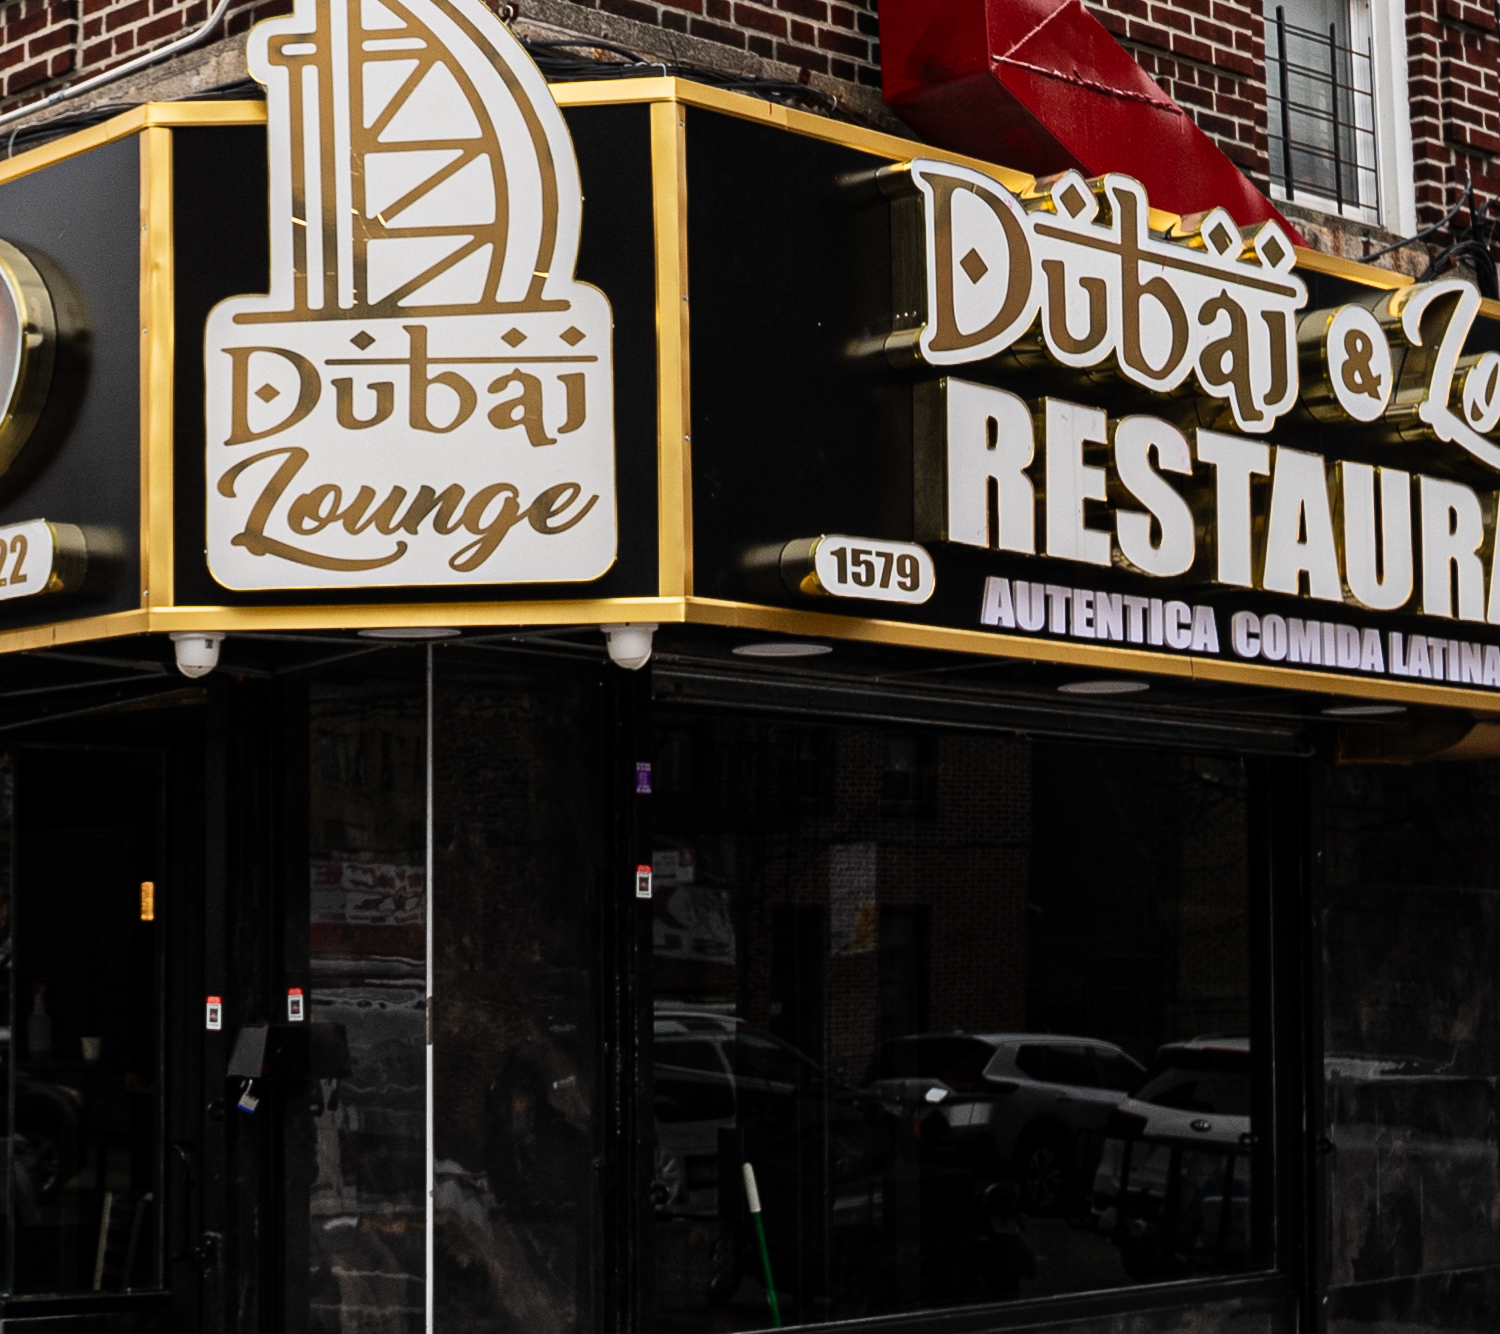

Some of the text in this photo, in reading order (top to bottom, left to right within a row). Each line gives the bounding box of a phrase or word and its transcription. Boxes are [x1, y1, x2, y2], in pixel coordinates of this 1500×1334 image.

[920, 162, 1305, 432] Dubai
[1340, 325, 1385, 402] &
[222, 323, 600, 450] Dubai
[217, 443, 600, 573] Lounge
[829, 544, 921, 595] 1579
[981, 575, 1219, 654] AUTENTICA
[1231, 610, 1385, 673] COMIDA
